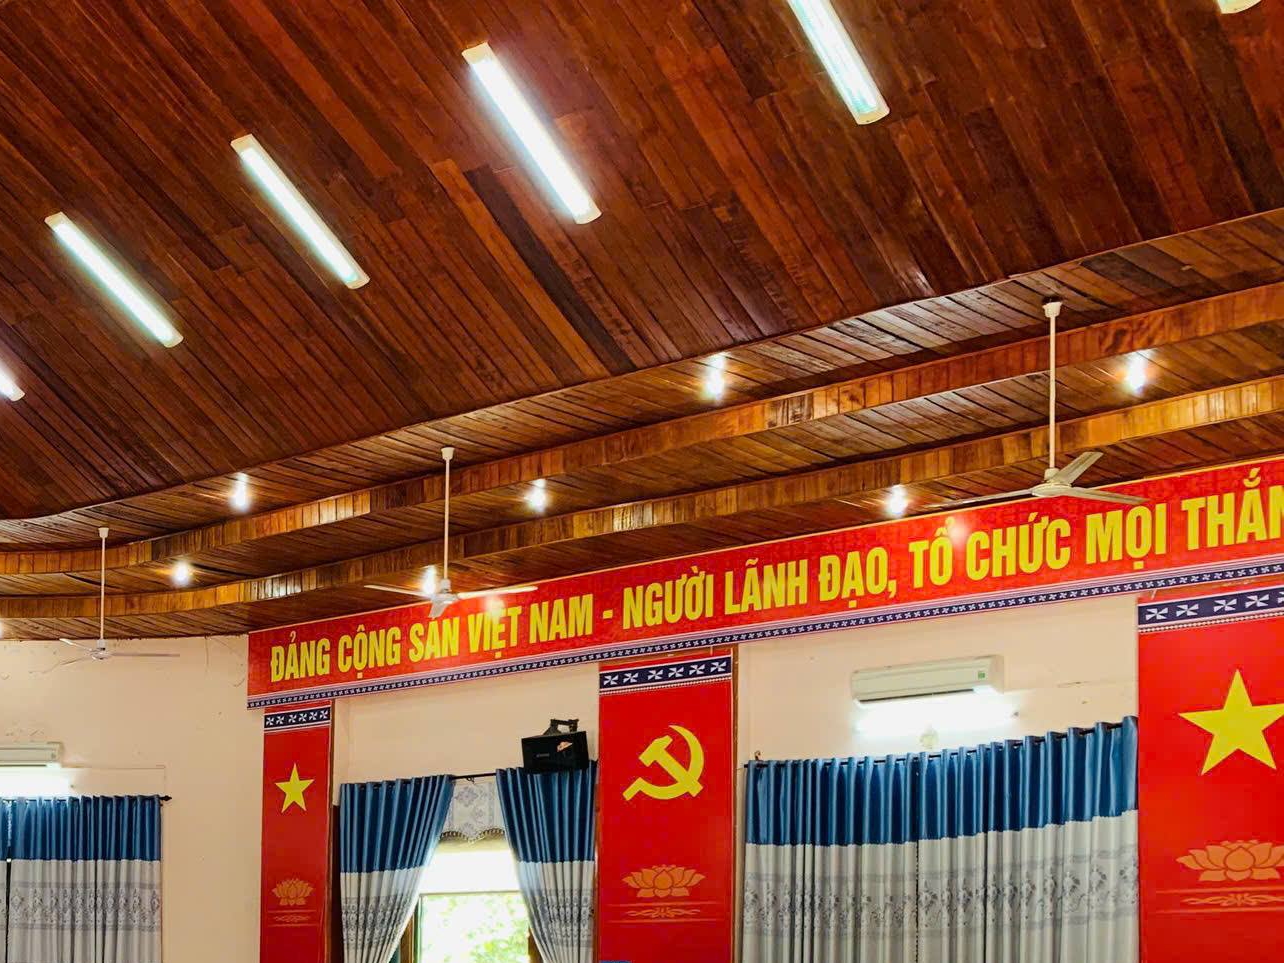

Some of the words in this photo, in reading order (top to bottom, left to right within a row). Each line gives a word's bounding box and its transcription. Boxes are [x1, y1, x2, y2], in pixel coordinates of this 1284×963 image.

[270, 630, 331, 683] ĐẢNG
[338, 624, 401, 679] CỘNG
[468, 603, 522, 659] VIỆT
[529, 594, 593, 644] NAM
[622, 565, 715, 630] NGƯỜI
[724, 558, 809, 615] LÃNH
[818, 546, 897, 609] ĐẠO,
[908, 516, 957, 589] TỔ
[966, 512, 1071, 581] CHỨC
[1085, 503, 1167, 570] MỌI
